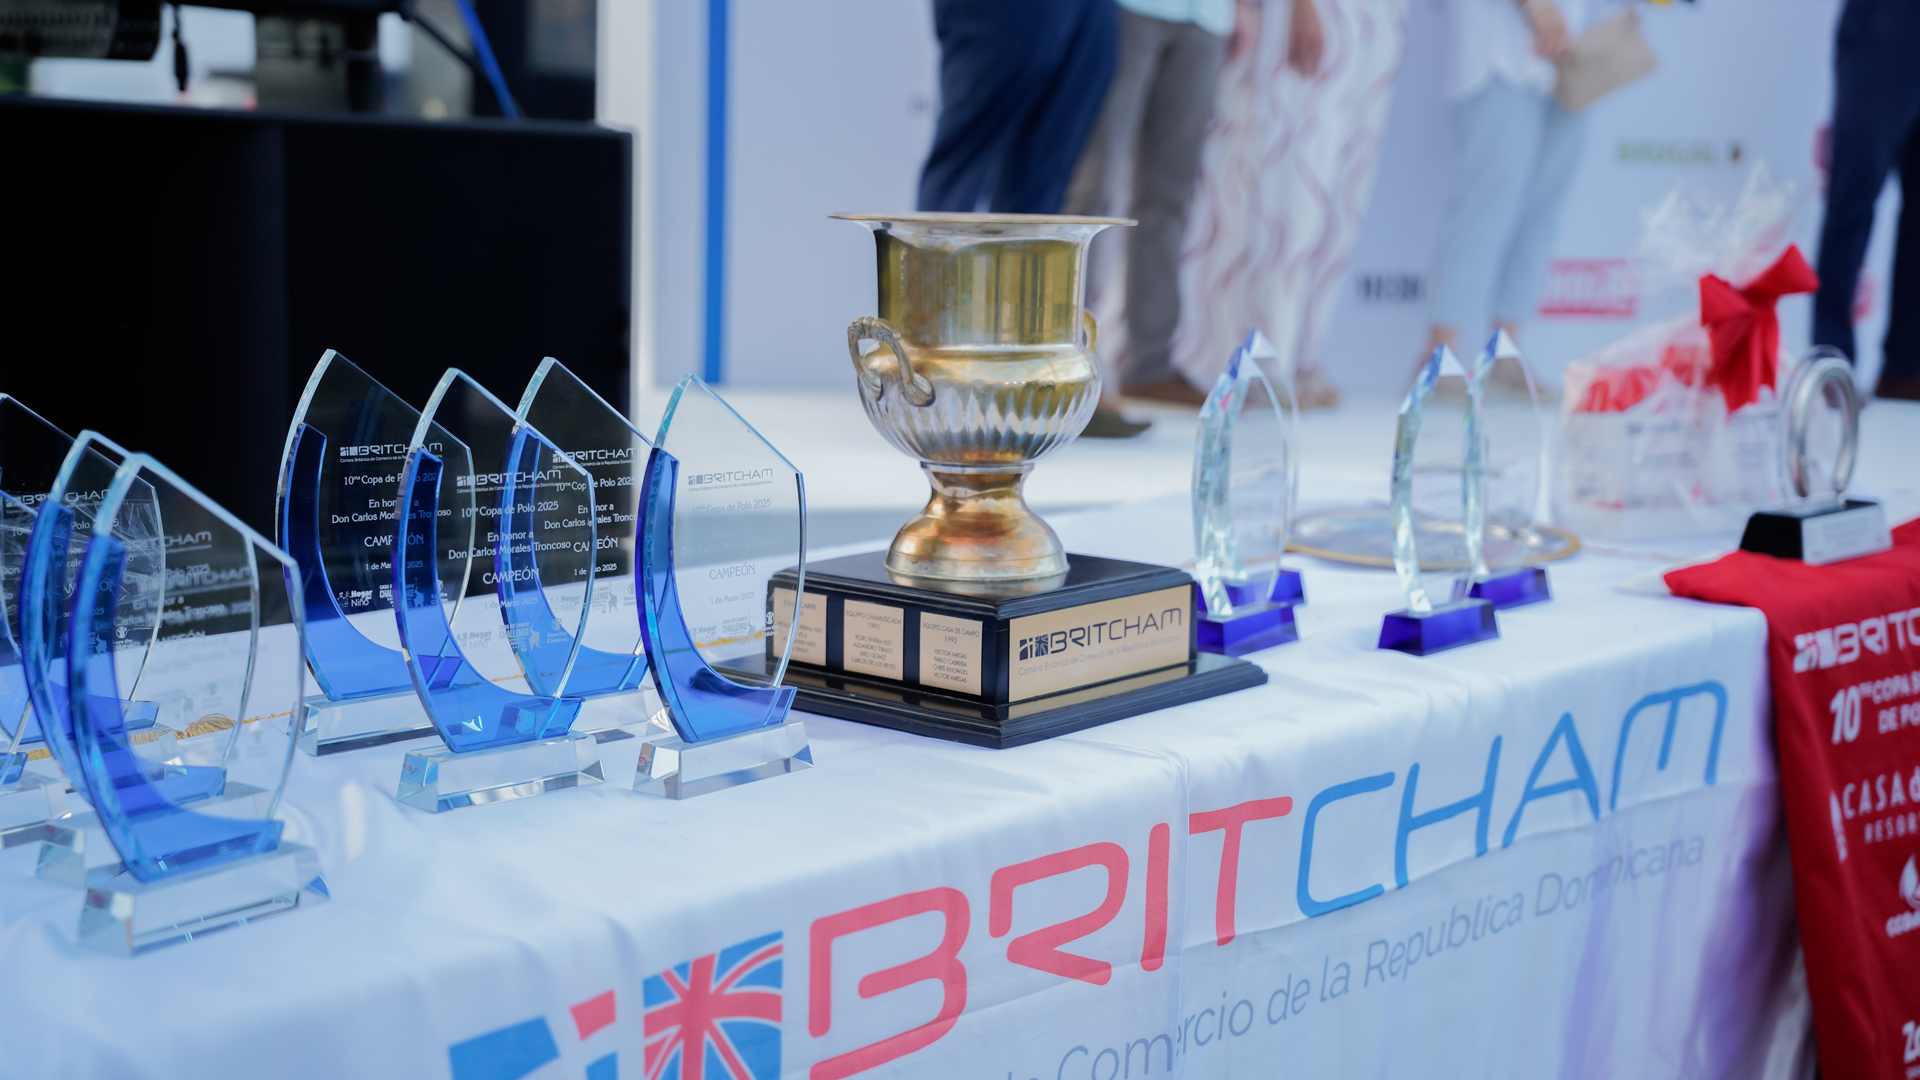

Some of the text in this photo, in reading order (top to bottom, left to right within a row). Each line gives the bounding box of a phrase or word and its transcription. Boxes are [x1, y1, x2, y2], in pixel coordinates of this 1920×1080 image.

[566, 448, 638, 461] BRITCHAM
[361, 474, 383, 486] Copa
[385, 474, 396, 483] de
[476, 469, 562, 486] BRITCHAM
[704, 468, 773, 484] BRITCHAM
[571, 476, 636, 492] Cop Polo 2025
[368, 499, 380, 508] En
[479, 506, 502, 518] Copa
[504, 505, 515, 514] de
[517, 503, 536, 514] Polo
[537, 500, 560, 512] 2025
[578, 504, 588, 514] En
[706, 498, 772, 514] Copa de Polo 2025
[331, 512, 378, 524] Don Carlos
[544, 520, 560, 530] Don
[562, 518, 586, 528] Carlos
[364, 531, 425, 547] CAMPÓN
[487, 530, 534, 542] En honor a
[448, 540, 572, 560] Don Carlos Morales Troncoso
[365, 563, 369, 571] 1
[370, 562, 380, 570] de
[579, 568, 587, 576] de
[602, 562, 618, 572] 2025
[709, 562, 756, 580] CAMPEÓN
[482, 566, 540, 585] CAMPEÓN
[484, 596, 539, 610] 1 de Marzo 2025
[714, 596, 722, 604] de
[724, 594, 740, 603] Marzo
[740, 592, 755, 600] 2025
[846, 610, 902, 624] EQUIPO CHAMUSCADA
[722, 622, 748, 634] CHALLENGE
[868, 622, 880, 630] 1991
[923, 622, 941, 630] EQUIPO
[962, 628, 980, 638] CAMPO
[1050, 608, 1182, 654] BRITCHAM
[470, 631, 492, 640] Hogar
[500, 628, 530, 640] CHALLENGE
[944, 635, 958, 644] 1992
[853, 642, 894, 654] ALEJANDRO TIRADO
[851, 656, 868, 664] CARLOS
[884, 662, 896, 670] REYES
[934, 656, 968, 667] PABLO CABRERA
[951, 652, 967, 660] VARGAS
[1070, 656, 1078, 664] de
[1079, 650, 1106, 663] Comercio
[1106, 649, 1114, 658] de
[933, 664, 968, 676] CHRIS KNOWLES
[934, 672, 968, 684] VICTOR VARGAS
[1872, 673, 1911, 705] COPA
[1878, 706, 1898, 735] DE
[1843, 770, 1907, 820] CASA
[808, 681, 1729, 1080] BRITCHAM
[1267, 970, 1310, 1026] de
[1320, 955, 1351, 1003] la
[1364, 890, 1525, 988] Republica
[1534, 831, 1706, 918] Dominicana
